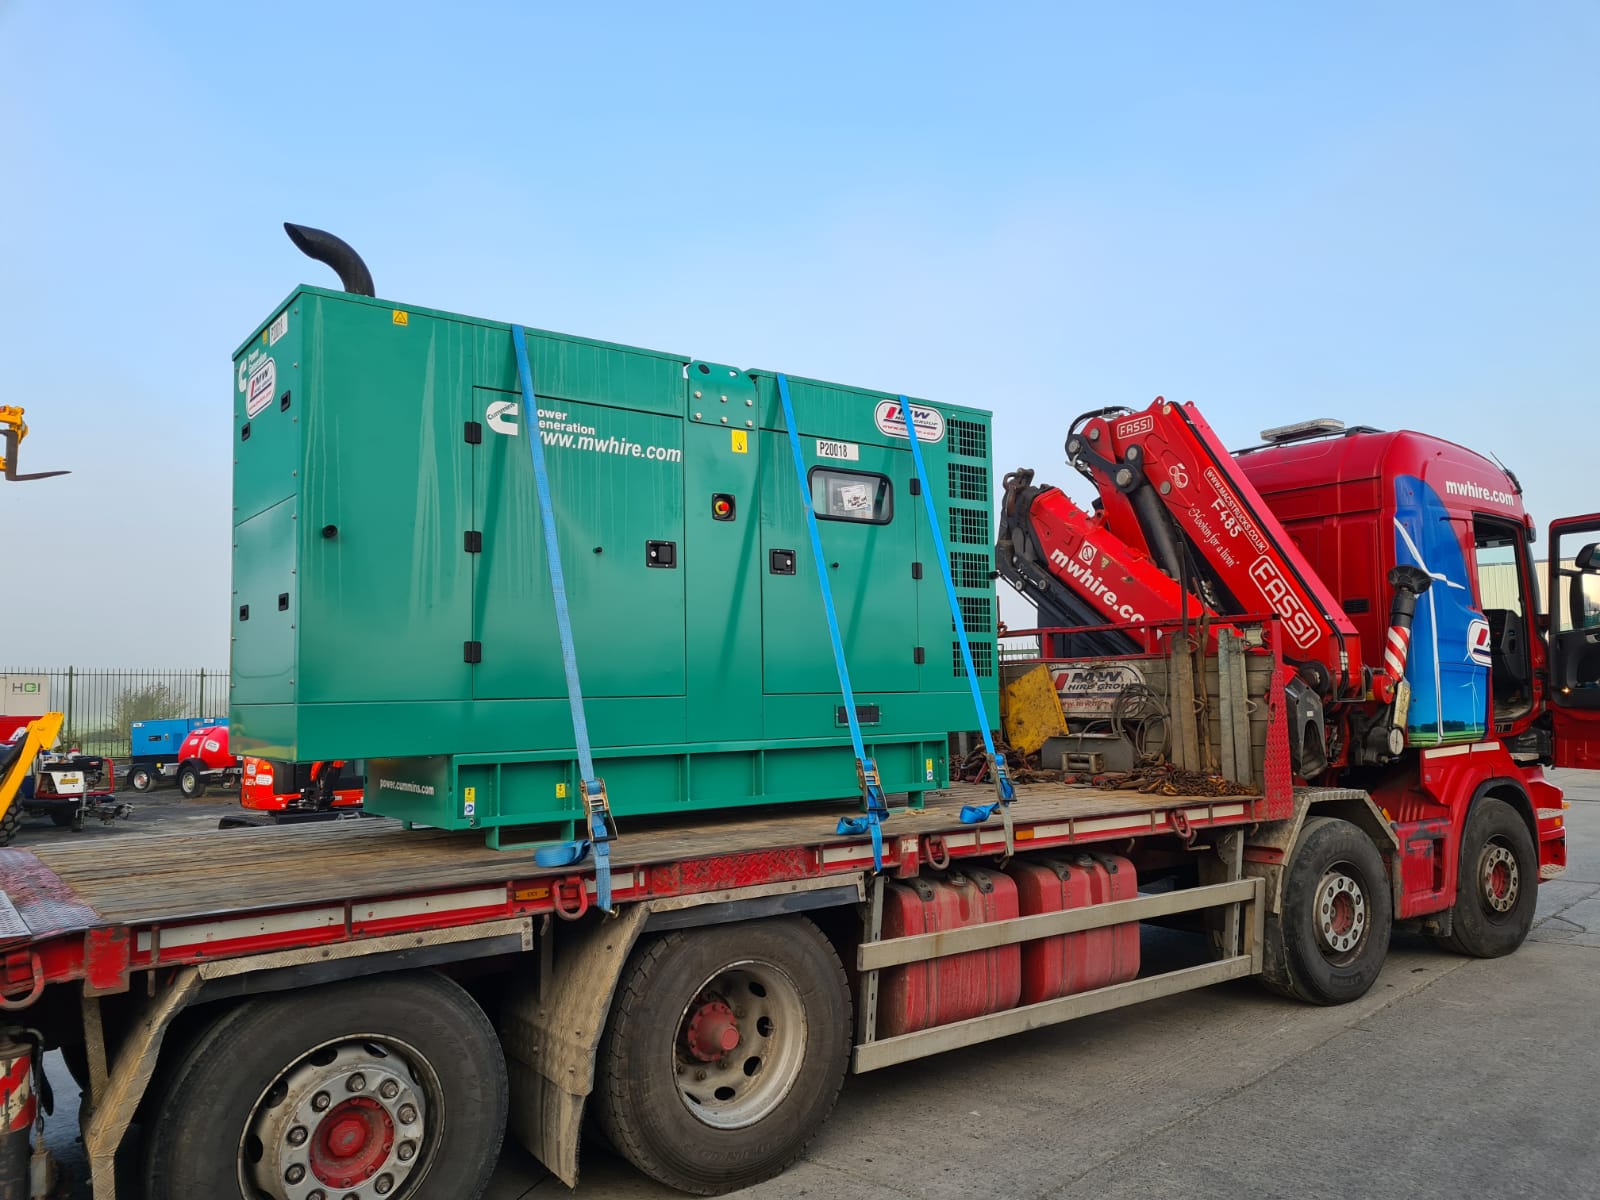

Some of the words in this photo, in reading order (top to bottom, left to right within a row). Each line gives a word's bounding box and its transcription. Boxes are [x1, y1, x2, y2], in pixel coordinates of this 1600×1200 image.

[537, 408, 568, 421] ower
[538, 420, 596, 436] eneration
[1120, 418, 1150, 437] FASSI
[538, 431, 681, 463] ww.mwhire.com
[820, 441, 848, 458] P20018
[1445, 480, 1514, 506] mwhire.com
[1206, 469, 1266, 551] WWW.MACSTRUCKS.CO.UK
[1050, 548, 1148, 635] mwhire.co
[1254, 562, 1315, 642] FASSI
[1097, 682, 1132, 691] GROU
[379, 779, 435, 796] power.cummins.com
